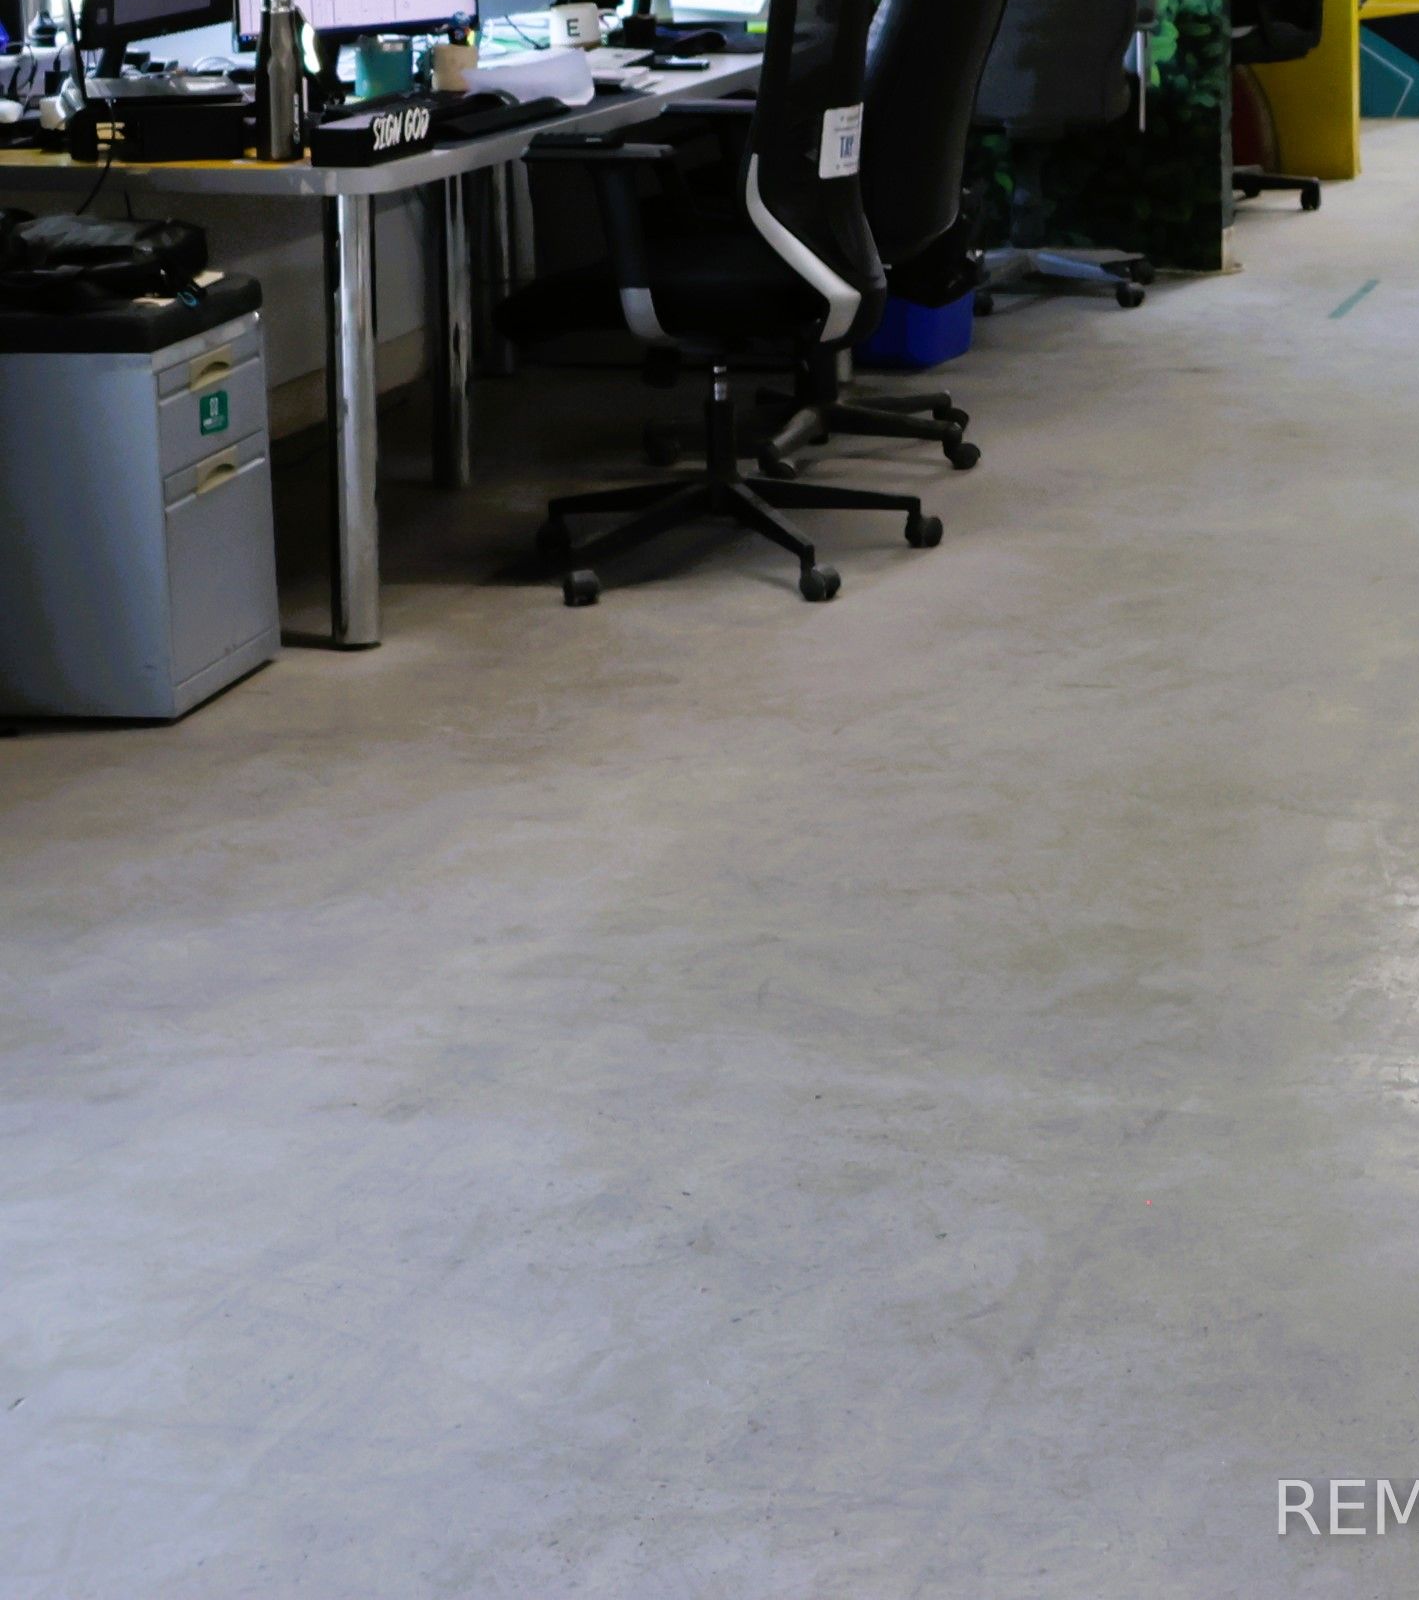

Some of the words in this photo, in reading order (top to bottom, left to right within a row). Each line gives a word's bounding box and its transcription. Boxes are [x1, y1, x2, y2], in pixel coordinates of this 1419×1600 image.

[566, 18, 580, 37] E
[373, 111, 403, 151] SIGN
[404, 107, 430, 142] GOD
